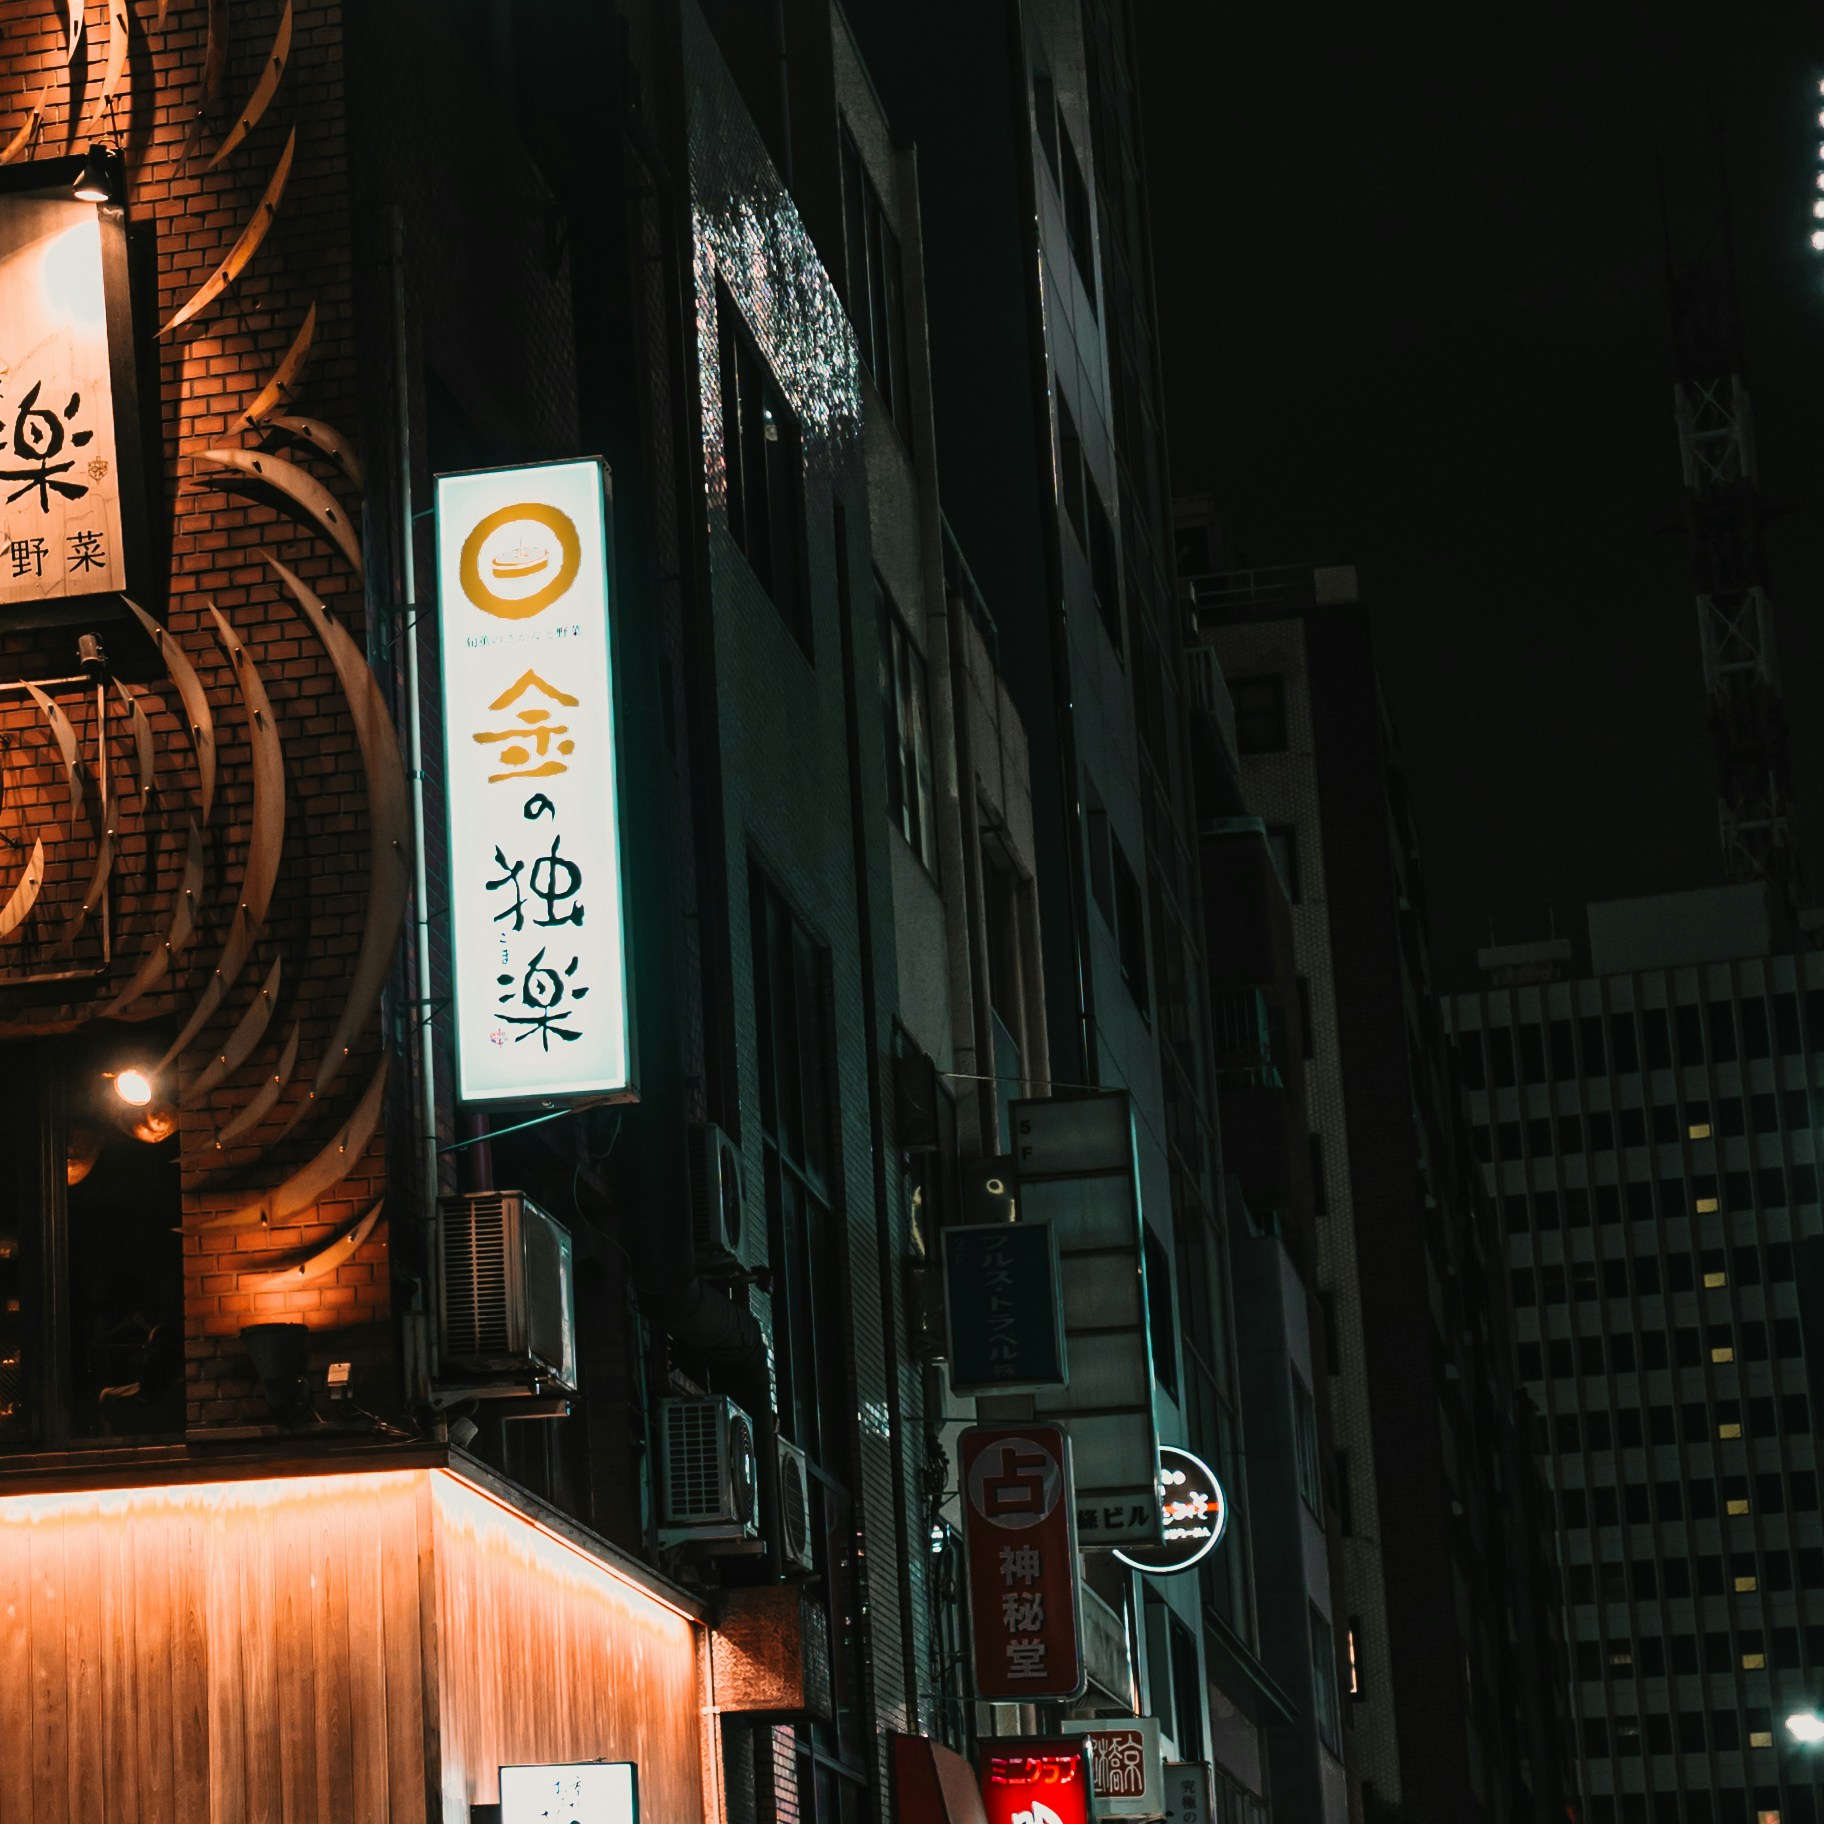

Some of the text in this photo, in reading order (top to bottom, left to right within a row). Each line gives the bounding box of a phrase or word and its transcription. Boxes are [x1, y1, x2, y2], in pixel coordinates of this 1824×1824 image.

[473, 668, 590, 1052] 金の独楽
[983, 1447, 1046, 1518] 占
[999, 1545, 1048, 1679] 神秘堂
